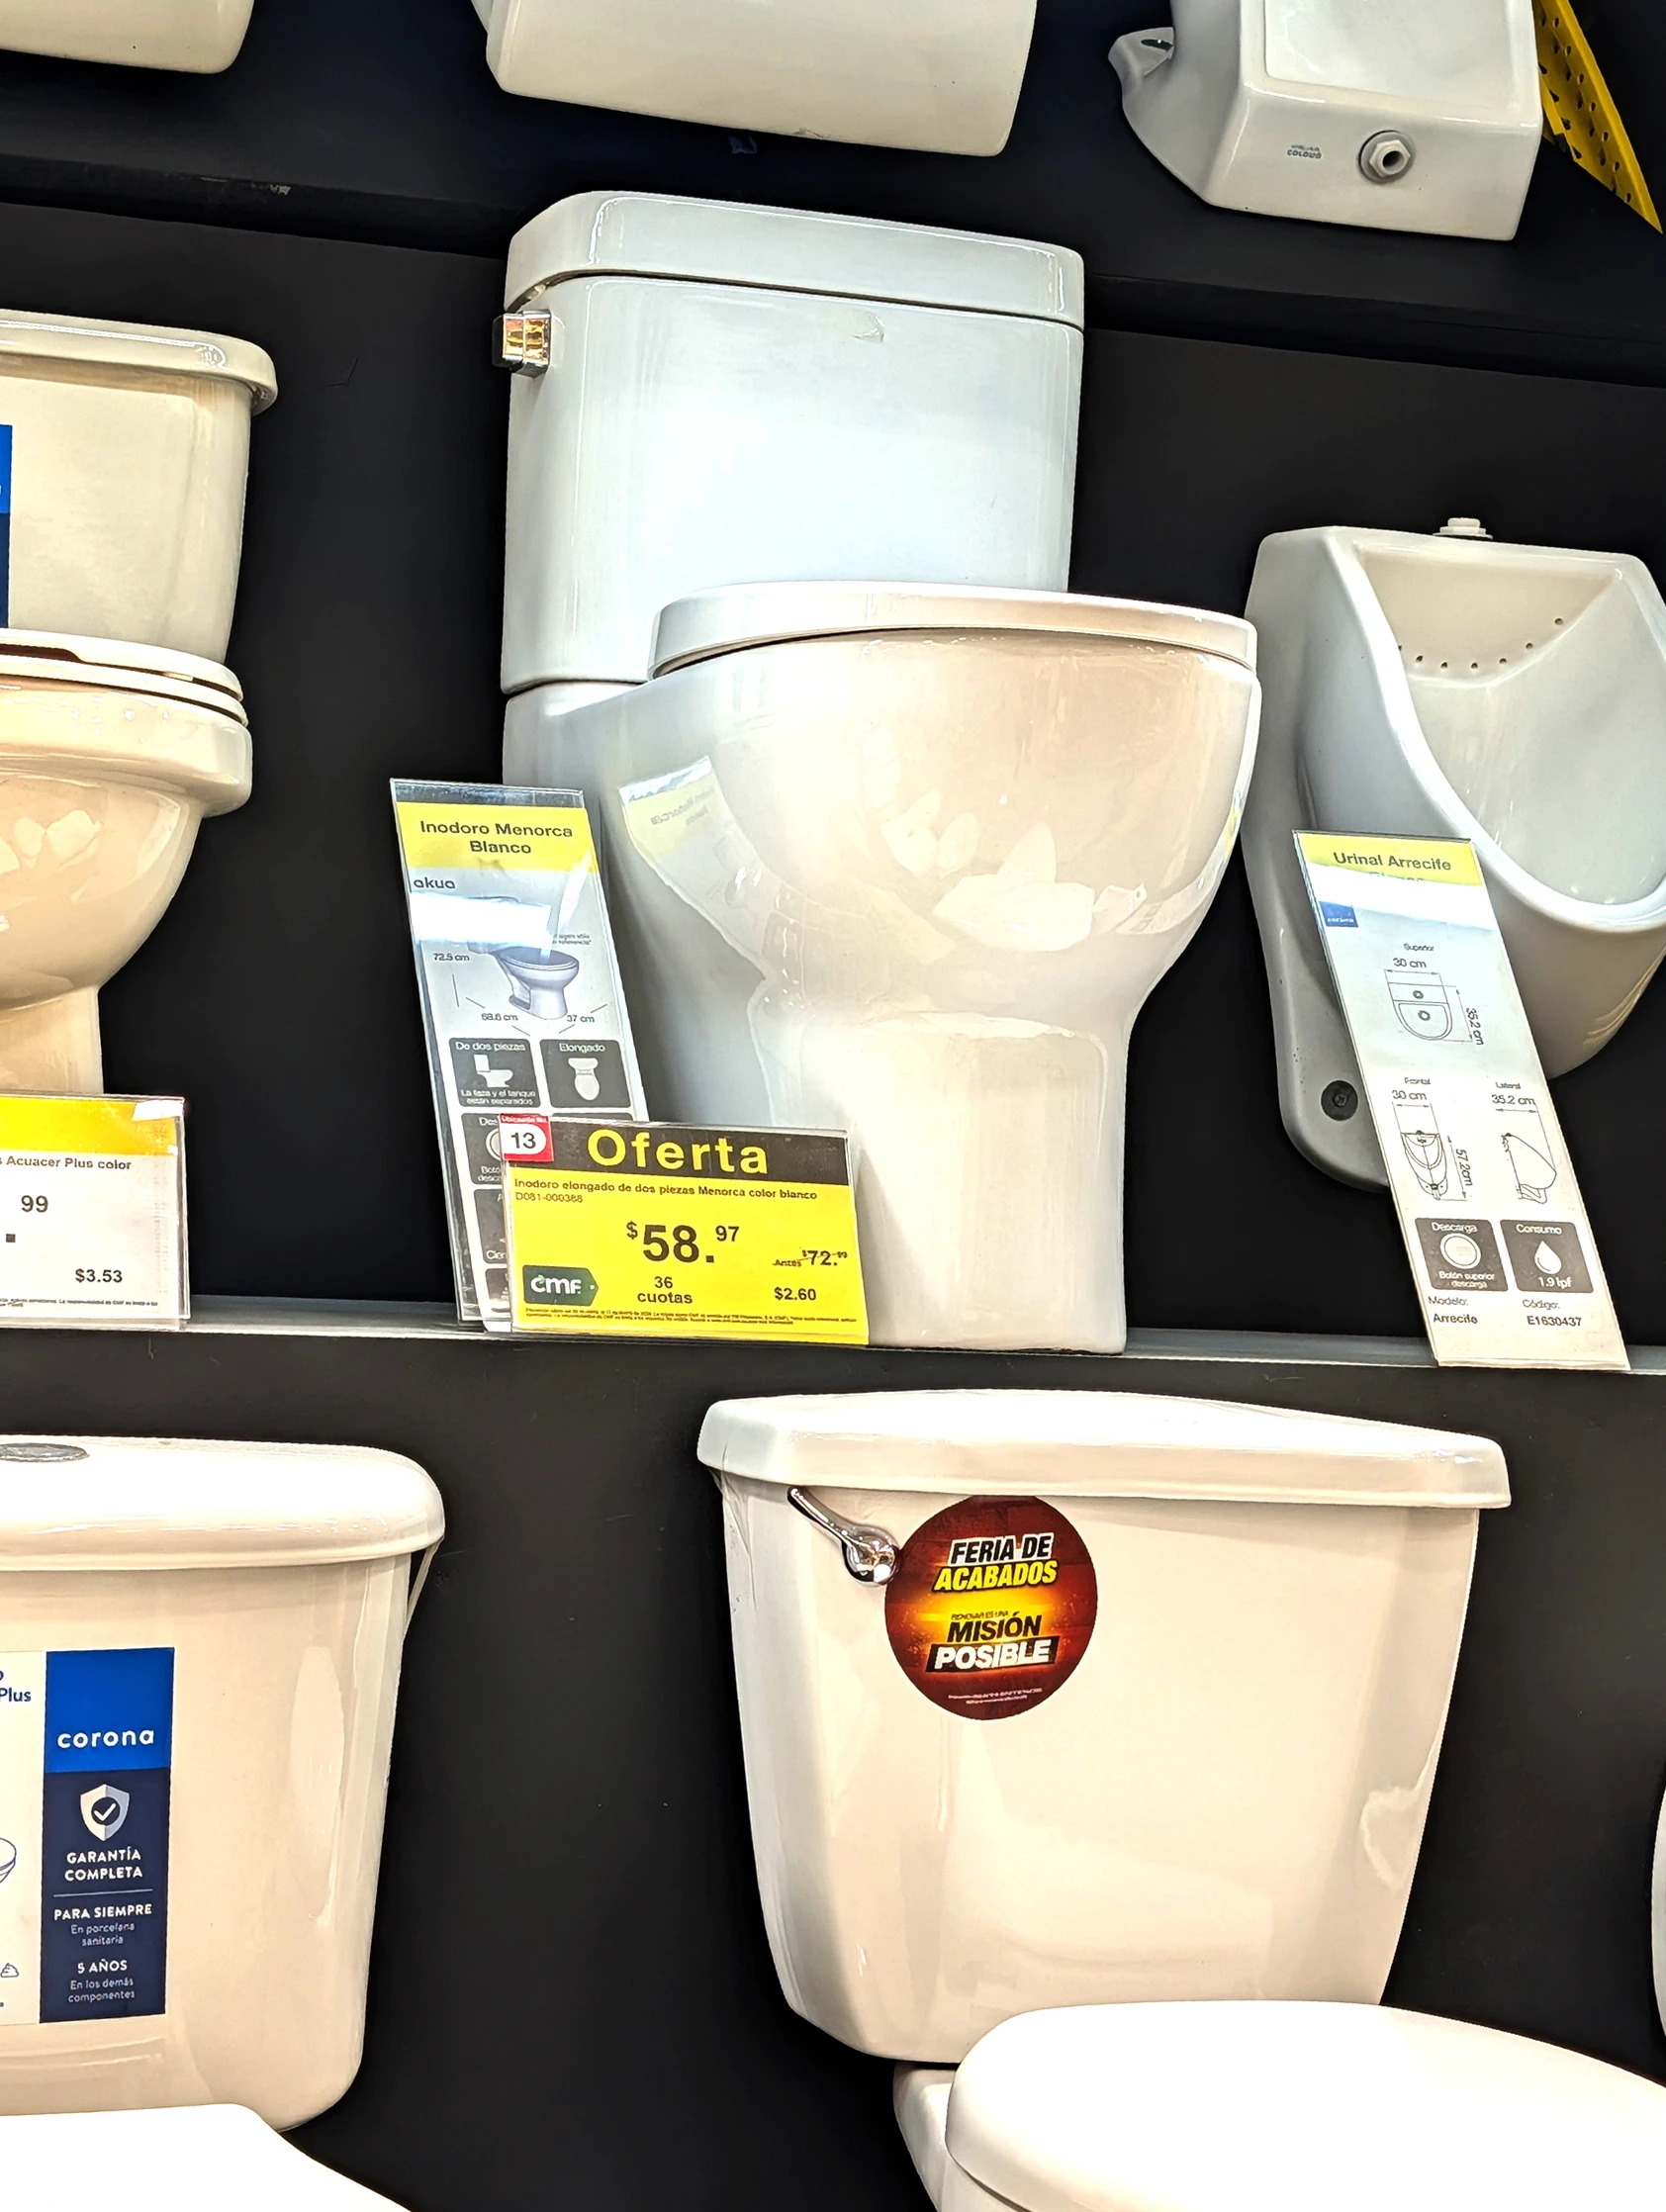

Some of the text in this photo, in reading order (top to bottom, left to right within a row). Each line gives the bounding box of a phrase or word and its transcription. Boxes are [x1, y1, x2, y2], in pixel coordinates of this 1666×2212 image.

[420, 820, 573, 838] Inodoro Menorca
[470, 840, 531, 854] Blanco
[1333, 852, 1451, 871] Urinal Arrecife
[413, 877, 456, 889] akua
[1403, 943, 1435, 953] Superior
[432, 953, 453, 962] 72.5
[1392, 958, 1427, 968] 30 cm
[566, 1014, 579, 1023] 37
[1472, 1031, 1484, 1046] cm
[455, 1041, 471, 1052] De
[473, 1042, 492, 1052] dos
[559, 1043, 606, 1054] Elongado
[1392, 1089, 1427, 1101] 30 cm
[1521, 1096, 1536, 1106] cm
[510, 1132, 536, 1150] 13
[588, 1128, 768, 1174] Oferta
[6, 1155, 60, 1167] Acuacer
[64, 1156, 94, 1168] Plus
[97, 1158, 132, 1170] color
[514, 1178, 817, 1200] Inodoro elongado de dos piezas Menorca color blanco
[1432, 1222, 1478, 1234] Descarga
[1516, 1224, 1562, 1235] Consumo
[75, 1268, 123, 1283] $3.53
[654, 1276, 673, 1289] 36
[1464, 1271, 1496, 1282] superior
[1538, 1276, 1555, 1287] 1.9
[637, 1291, 693, 1305] cuotas
[774, 1286, 817, 1301] $2.60
[1428, 1296, 1469, 1306] Modelo:
[1522, 1298, 1561, 1310] Código:
[1433, 1313, 1478, 1325] Arrecife
[1527, 1315, 1583, 1327] E1630437
[951, 1535, 1053, 1564] FERIA DE
[934, 1560, 1059, 1591] ACABADOS
[947, 1611, 1043, 1643] MISIÓN
[934, 1638, 1053, 1670] POSIBLE
[0, 1687, 31, 1703] Plus
[57, 1727, 155, 1749] corona
[66, 1845, 141, 1865] GARANTÍA
[64, 1865, 143, 1882] COMPLETA
[53, 1902, 153, 1921] PARA SIEMPRE
[70, 1921, 136, 1937] En porcelana
[81, 1934, 124, 1947] sanitaria
[77, 1956, 129, 1975] 5 AÑOS
[70, 1977, 135, 1989] En los demás
[68, 1989, 136, 2004] componentes
